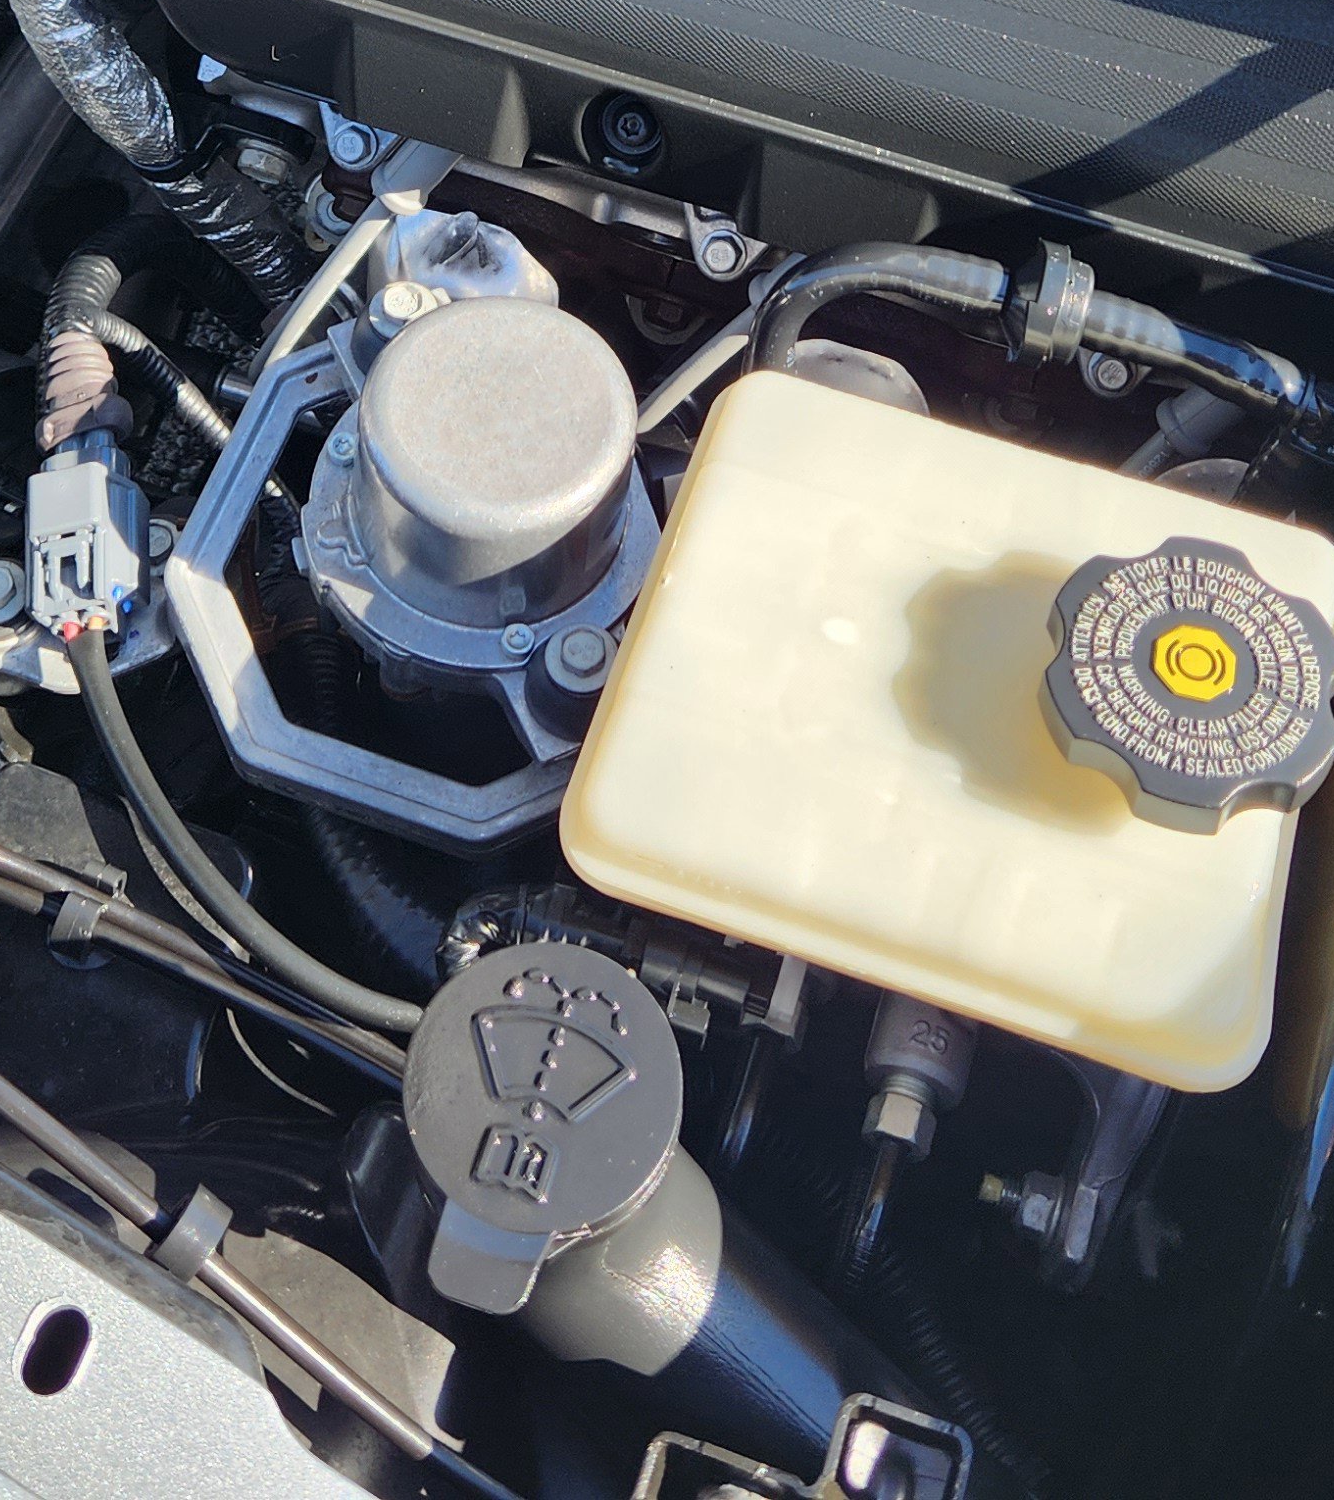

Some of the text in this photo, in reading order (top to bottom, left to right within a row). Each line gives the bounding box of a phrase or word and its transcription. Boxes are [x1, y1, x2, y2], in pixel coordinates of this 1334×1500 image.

[1114, 594, 1170, 659] PROVENANT
[1210, 598, 1258, 641] BIDON
[1136, 575, 1171, 600] QUE
[1170, 573, 1192, 592] DU
[1195, 575, 1254, 611] LIQUIDE
[1264, 622, 1297, 663] FREIN
[1173, 555, 1192, 573] LE
[1196, 558, 1266, 601] BOUCHON
[1260, 593, 1304, 633] AVANT
[1292, 633, 1314, 655] LA
[1107, 688, 1158, 740] BEFORE
[1236, 725, 1270, 754] USE
[1261, 700, 1293, 739] ONLY
[1176, 717, 1229, 738] CLEAN
[1226, 692, 1273, 733] FILLER
[1125, 733, 1171, 770] FROM
[1170, 754, 1185, 772] A
[1185, 757, 1243, 780] SEALED
[909, 1020, 950, 1056] 25
